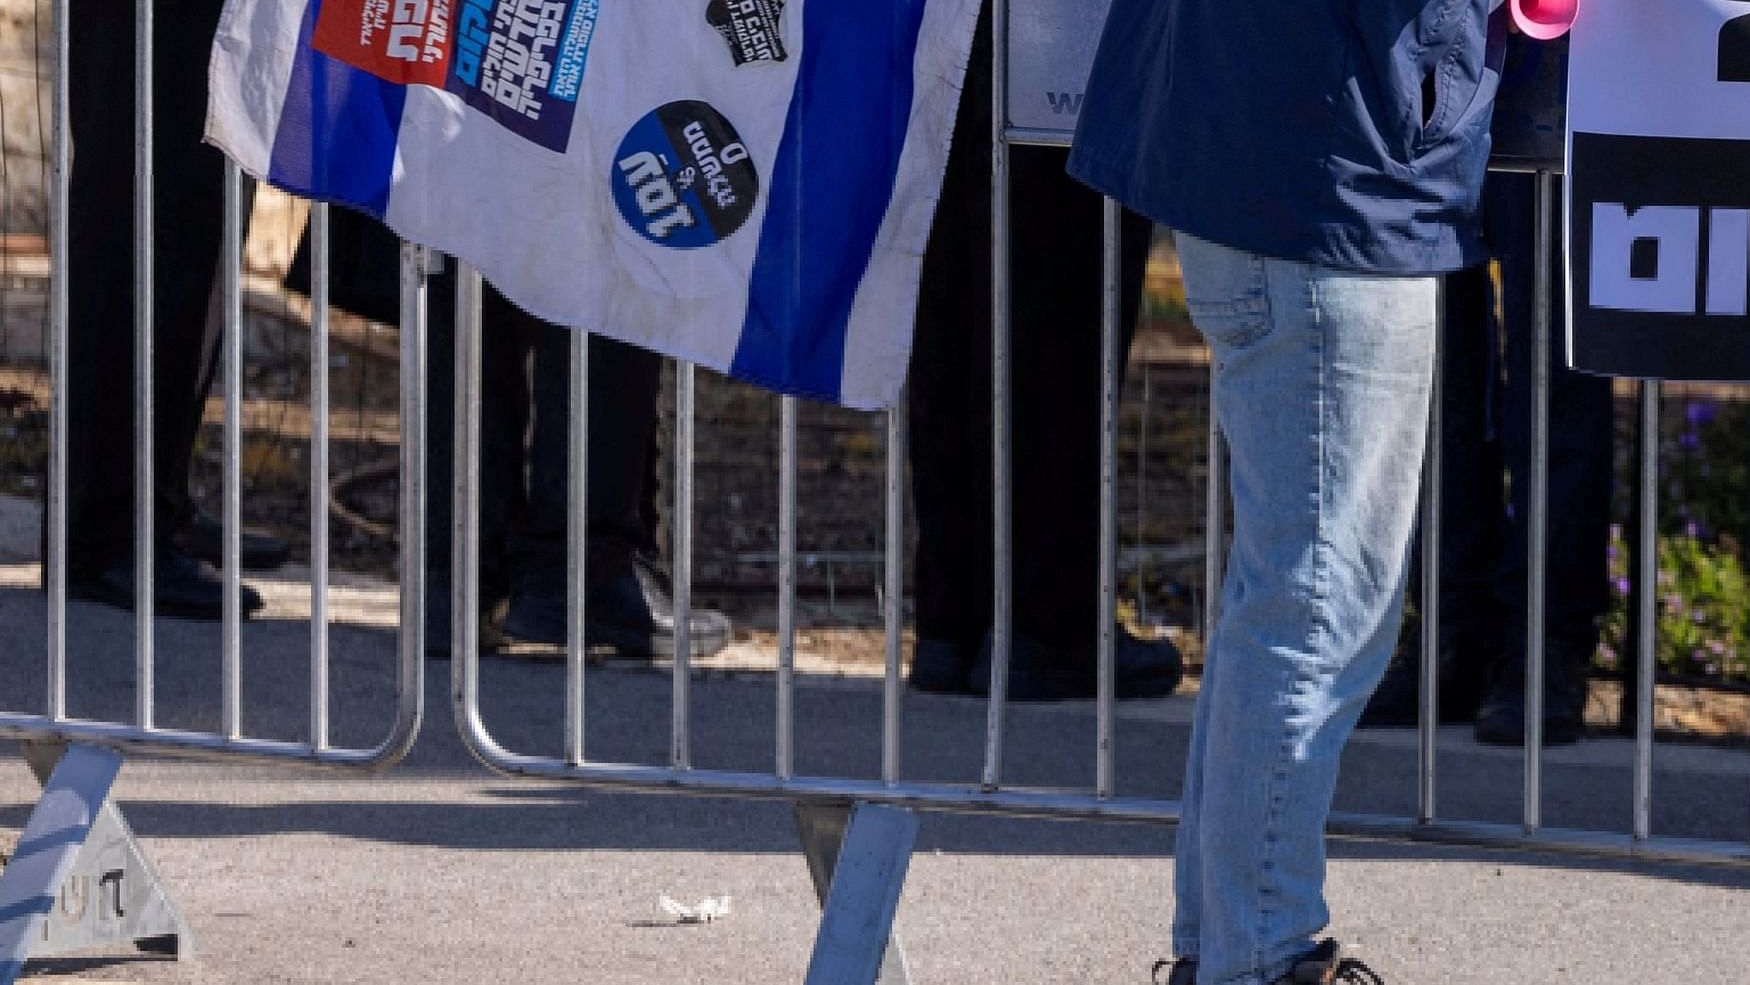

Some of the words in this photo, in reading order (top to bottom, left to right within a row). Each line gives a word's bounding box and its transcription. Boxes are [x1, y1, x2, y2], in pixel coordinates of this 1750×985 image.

[482, 32, 505, 98] חולים
[517, 0, 566, 120] בפריפריה
[746, 16, 772, 60] כיבוש
